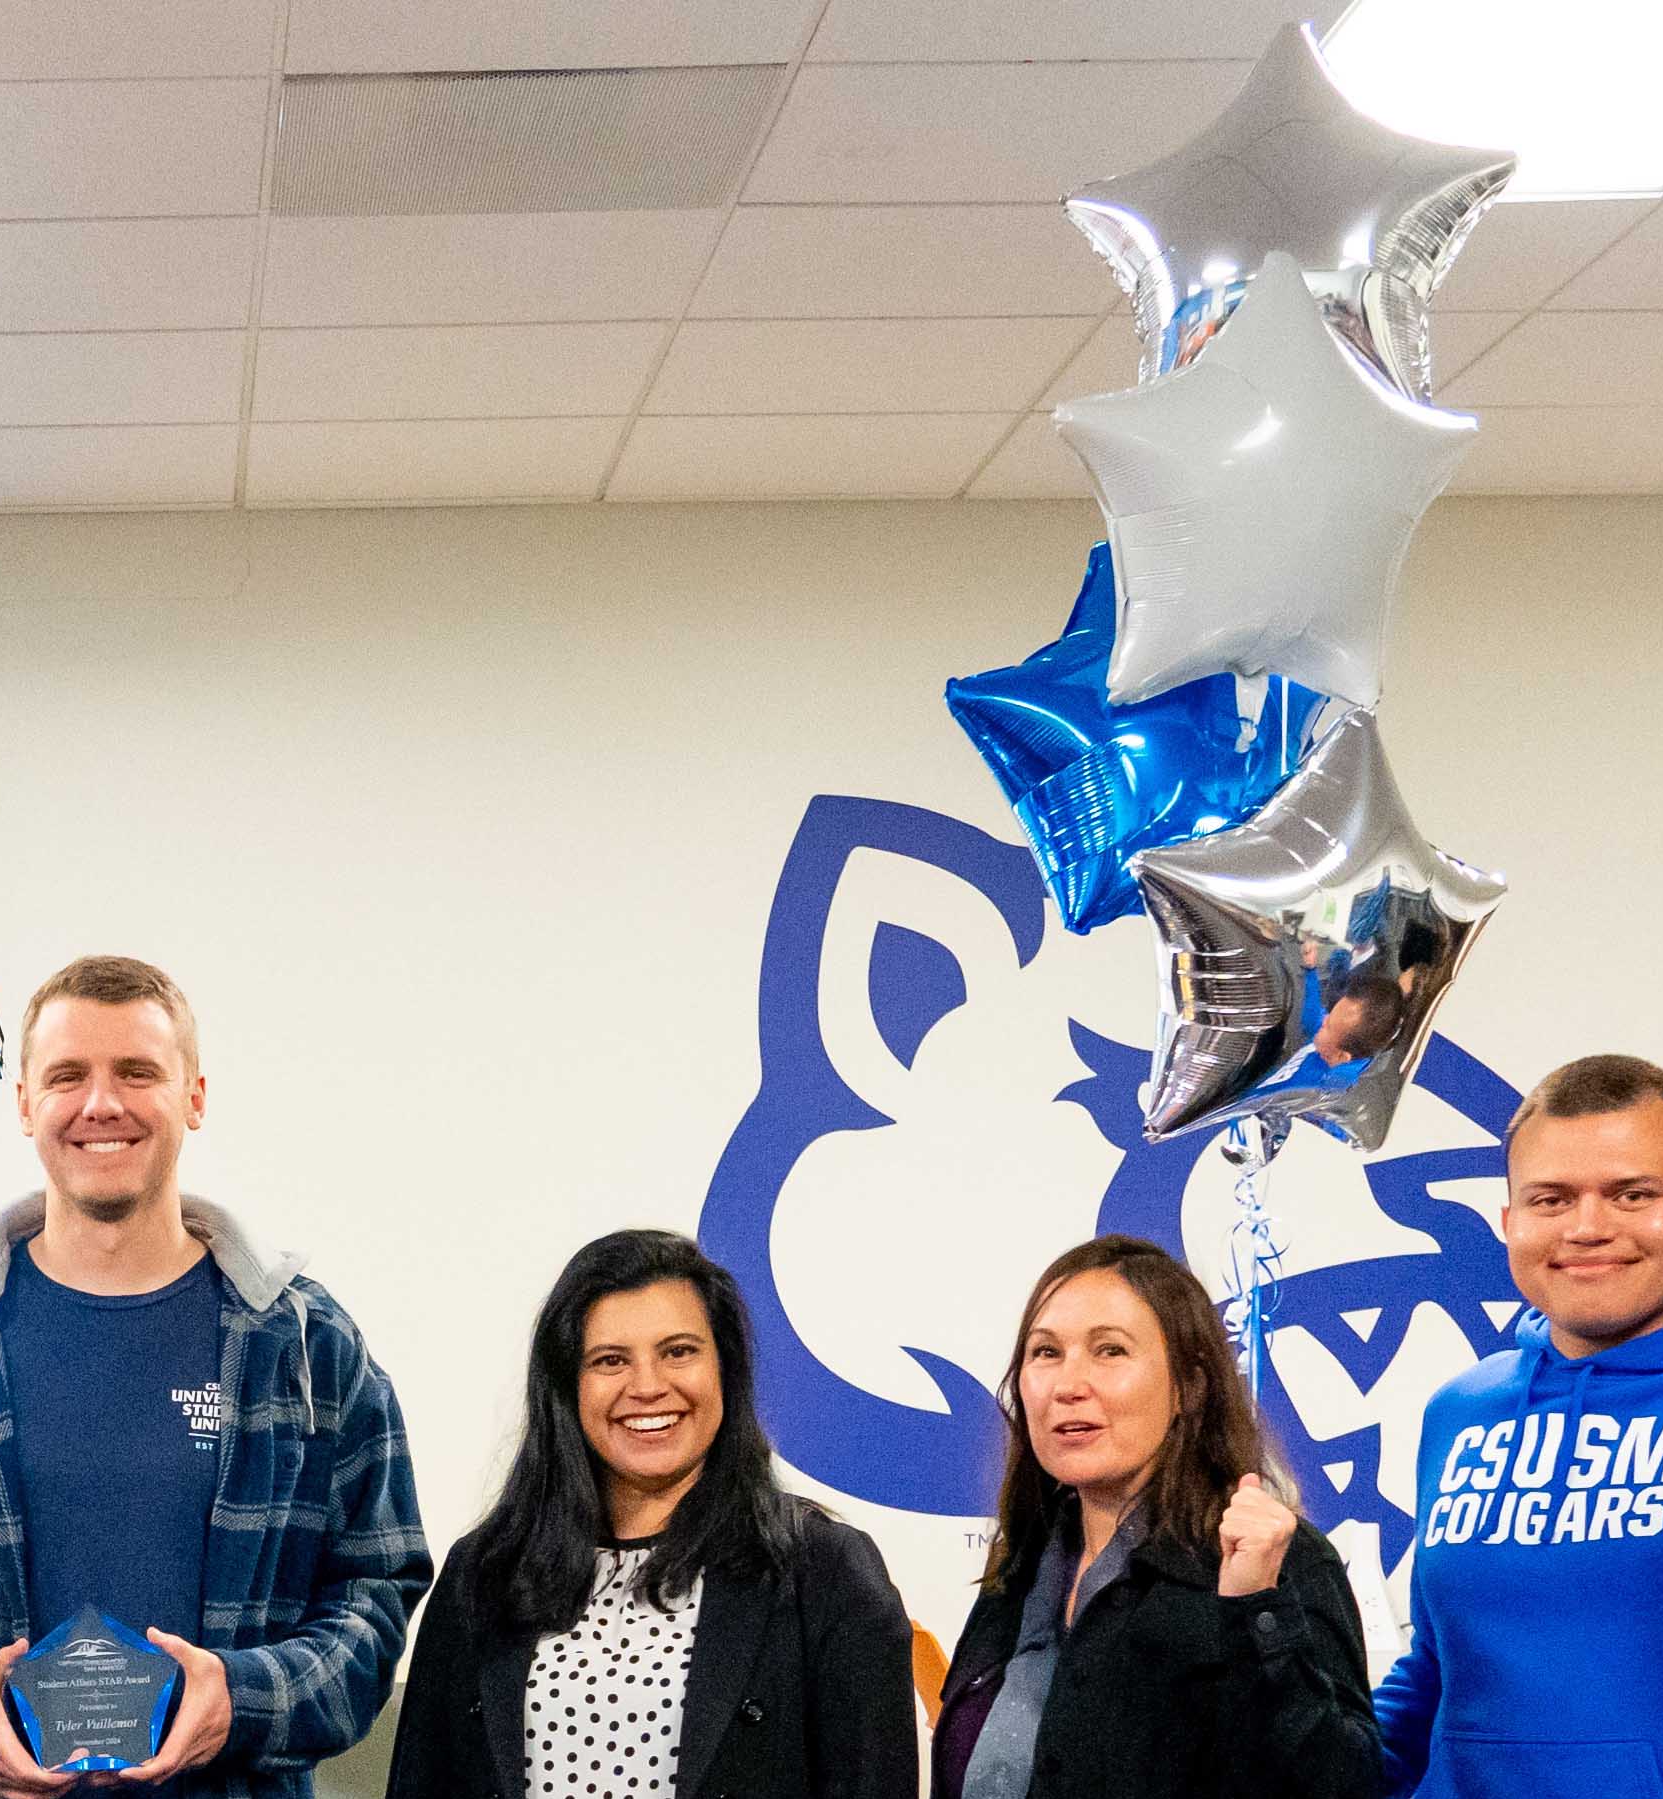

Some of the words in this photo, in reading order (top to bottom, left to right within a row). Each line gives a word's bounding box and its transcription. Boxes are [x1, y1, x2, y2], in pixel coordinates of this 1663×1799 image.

[171, 1389, 221, 1404] UNIVE
[182, 1403, 221, 1418] STUD
[190, 1416, 221, 1431] UNI
[195, 1441, 214, 1451] EST
[37, 1679, 69, 1689] Student
[69, 1678, 97, 1688] Affairs
[98, 1676, 123, 1687] STAR
[124, 1675, 150, 1685] Award
[56, 1719, 83, 1734] Tyler
